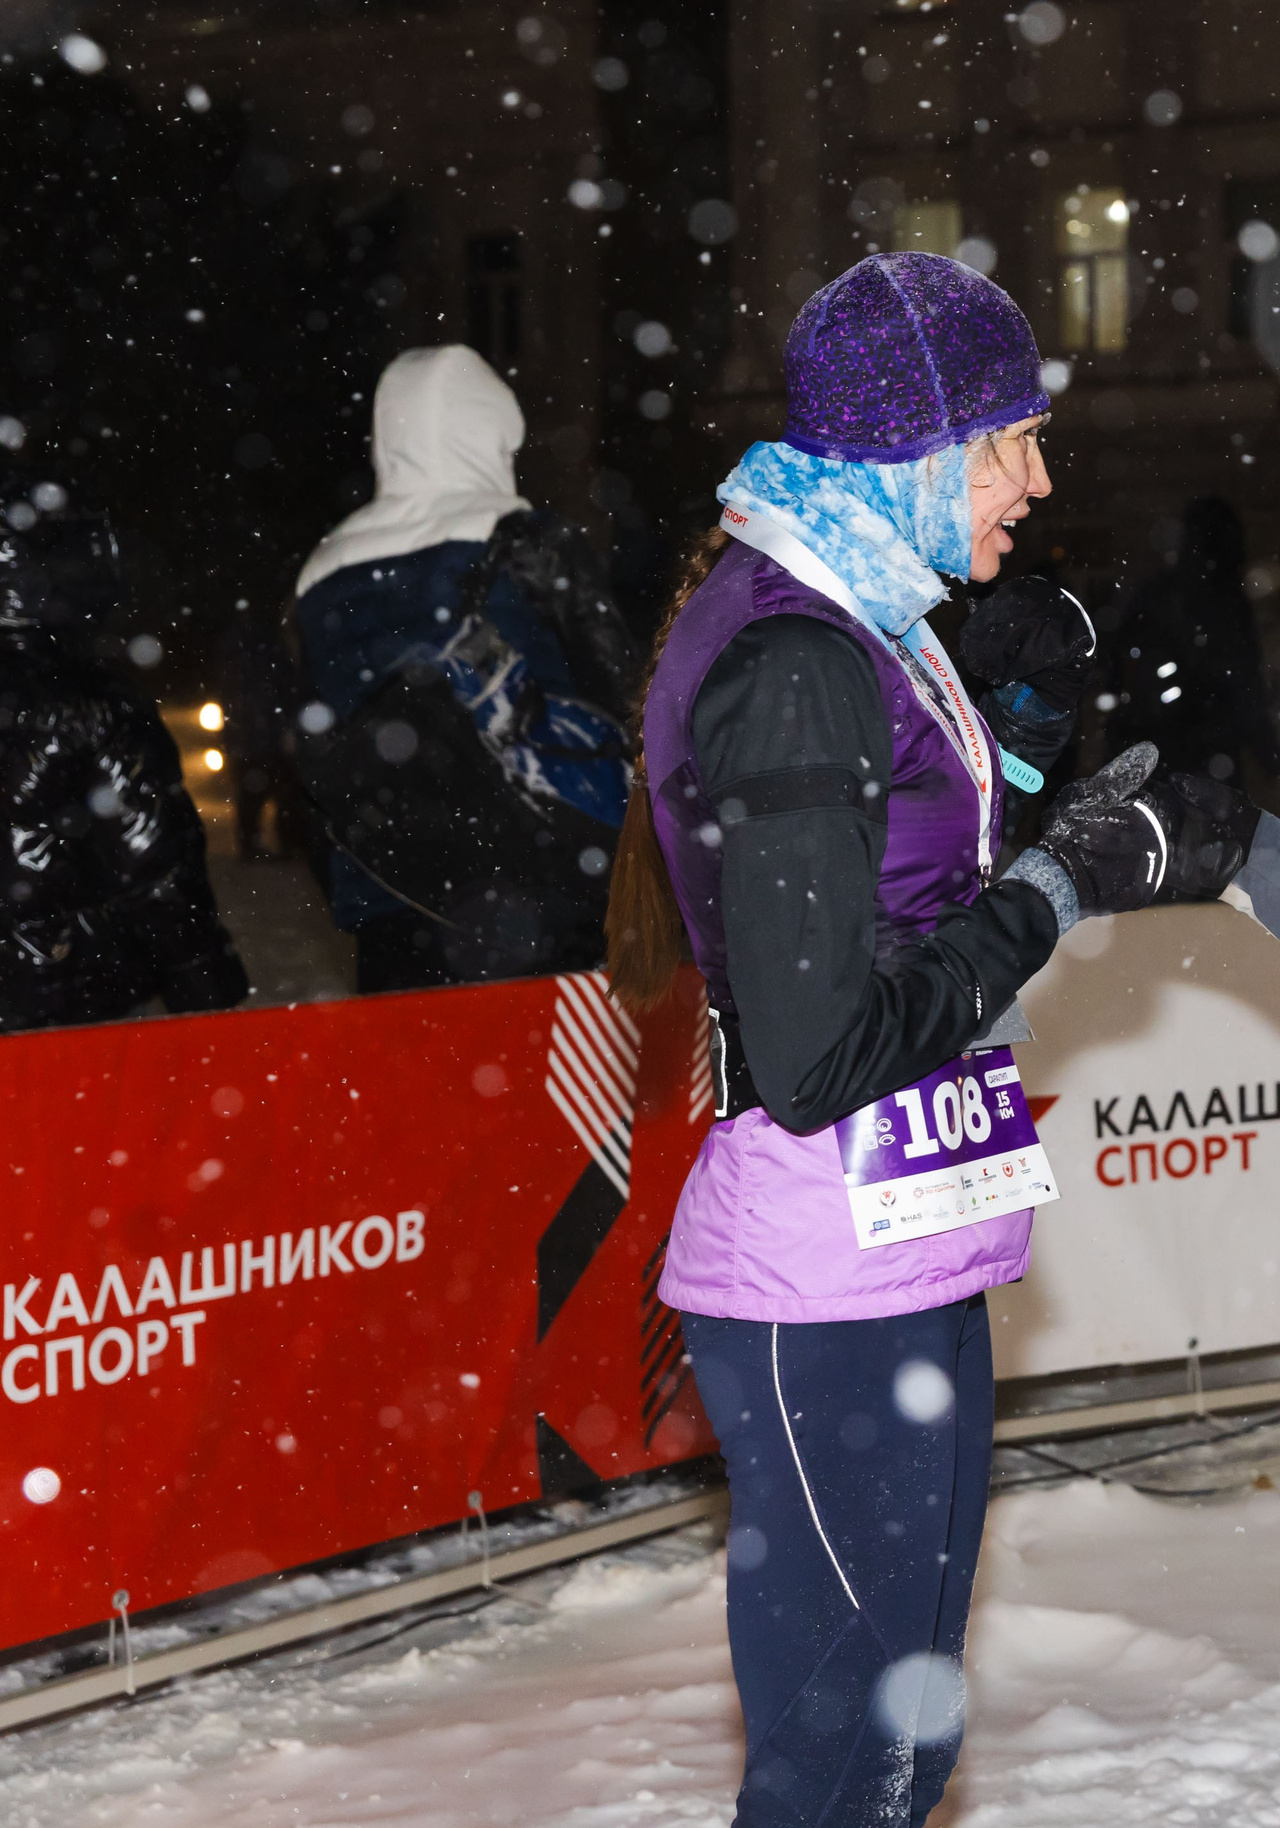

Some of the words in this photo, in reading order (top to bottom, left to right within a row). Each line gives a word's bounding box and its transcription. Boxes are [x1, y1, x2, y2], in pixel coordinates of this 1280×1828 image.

[724, 507, 749, 528] СПОРТ
[919, 646, 948, 678] СПОРТ
[944, 681, 983, 768] КАЛАШНИКОВ
[894, 1075, 992, 1160] 108
[995, 1090, 1010, 1107] 15
[1095, 1131, 1259, 1187] СПОРТ
[3, 1210, 426, 1340] КАЛАШНИКОВ
[1, 1310, 207, 1404] СПОРТ
